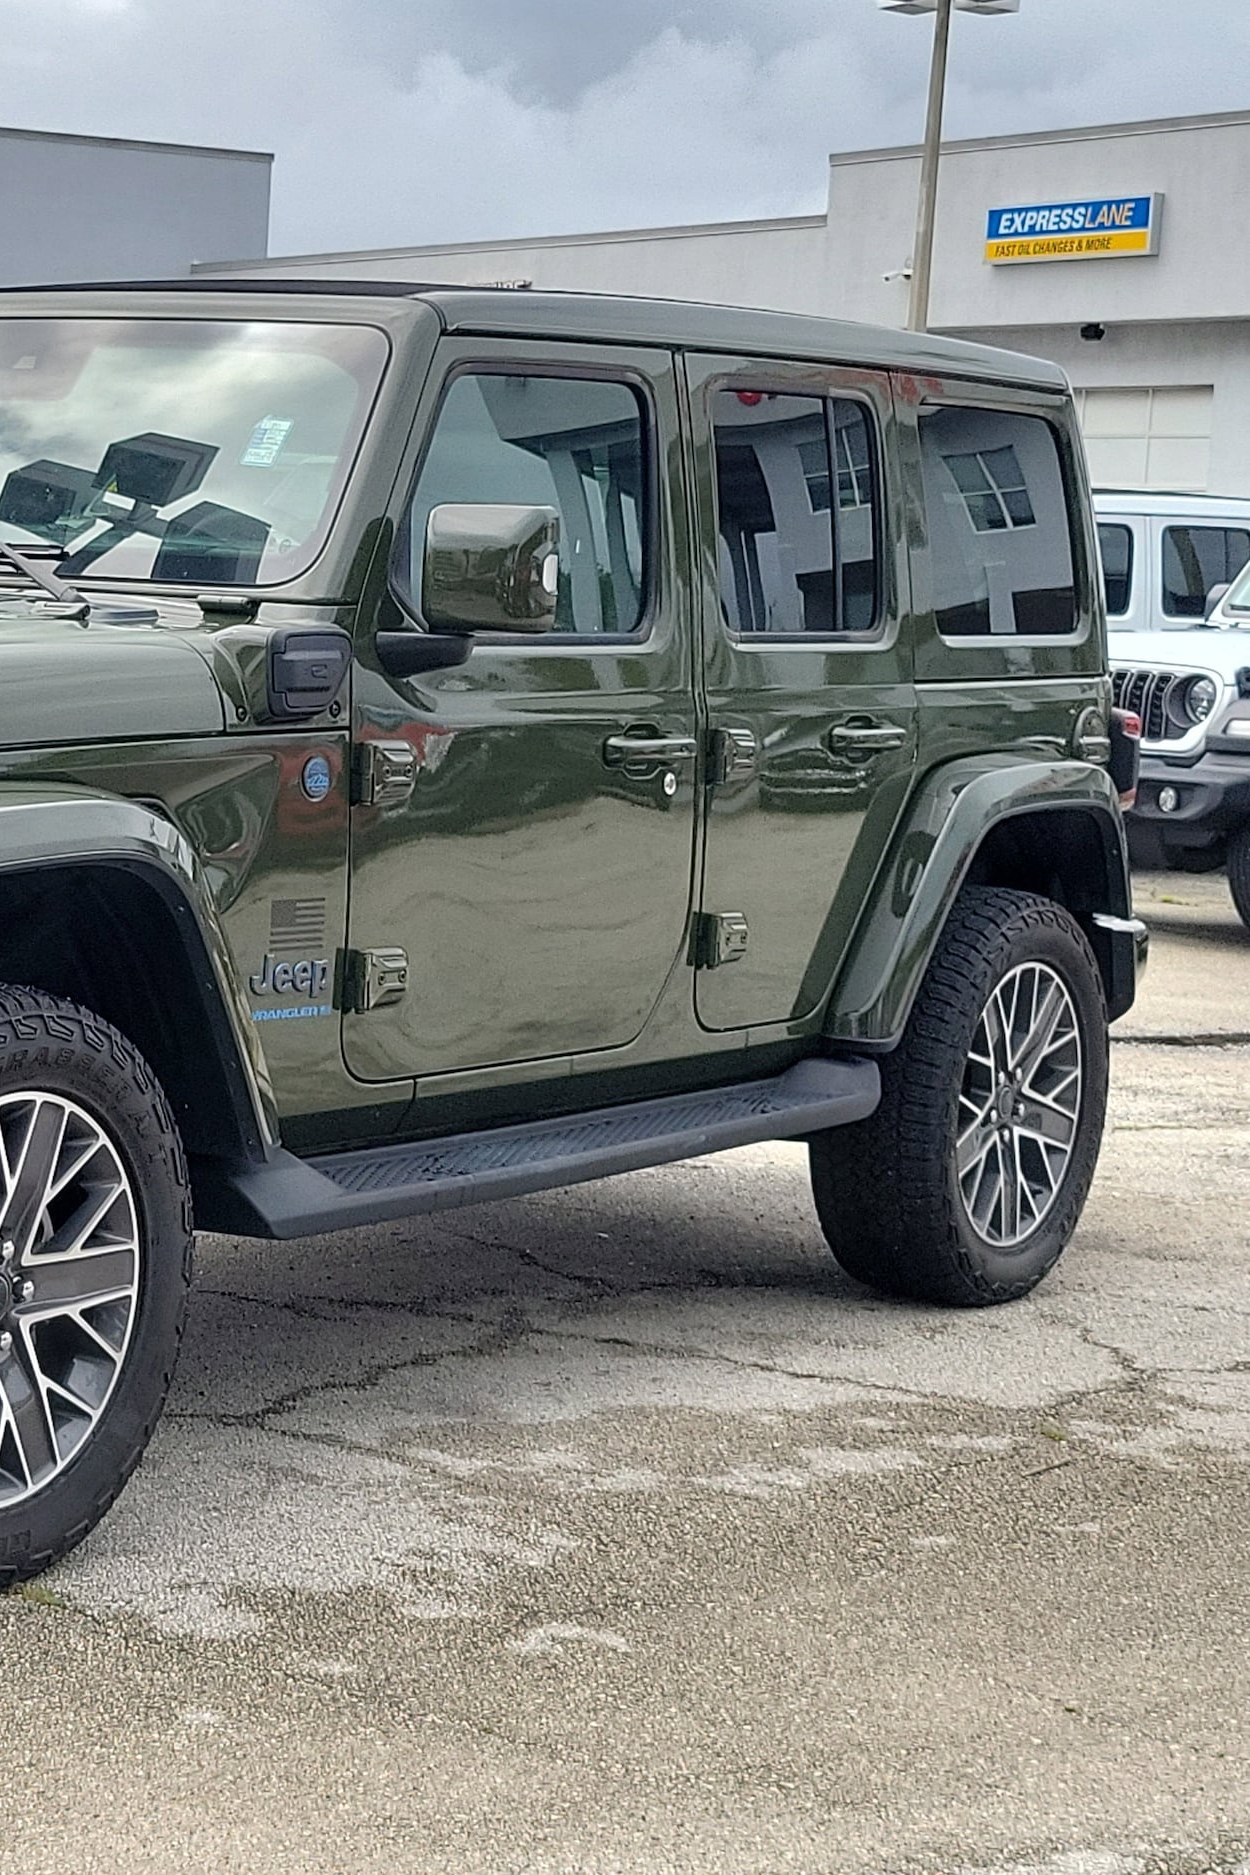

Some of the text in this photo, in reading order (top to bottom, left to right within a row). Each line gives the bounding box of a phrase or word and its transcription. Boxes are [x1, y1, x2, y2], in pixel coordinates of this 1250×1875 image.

[998, 202, 1136, 235] EXPRESSLANE
[995, 237, 1112, 258] FAST OIL CHANGES & MORE
[249, 953, 328, 998] Jeep
[252, 1005, 319, 1021] WRANGLER
